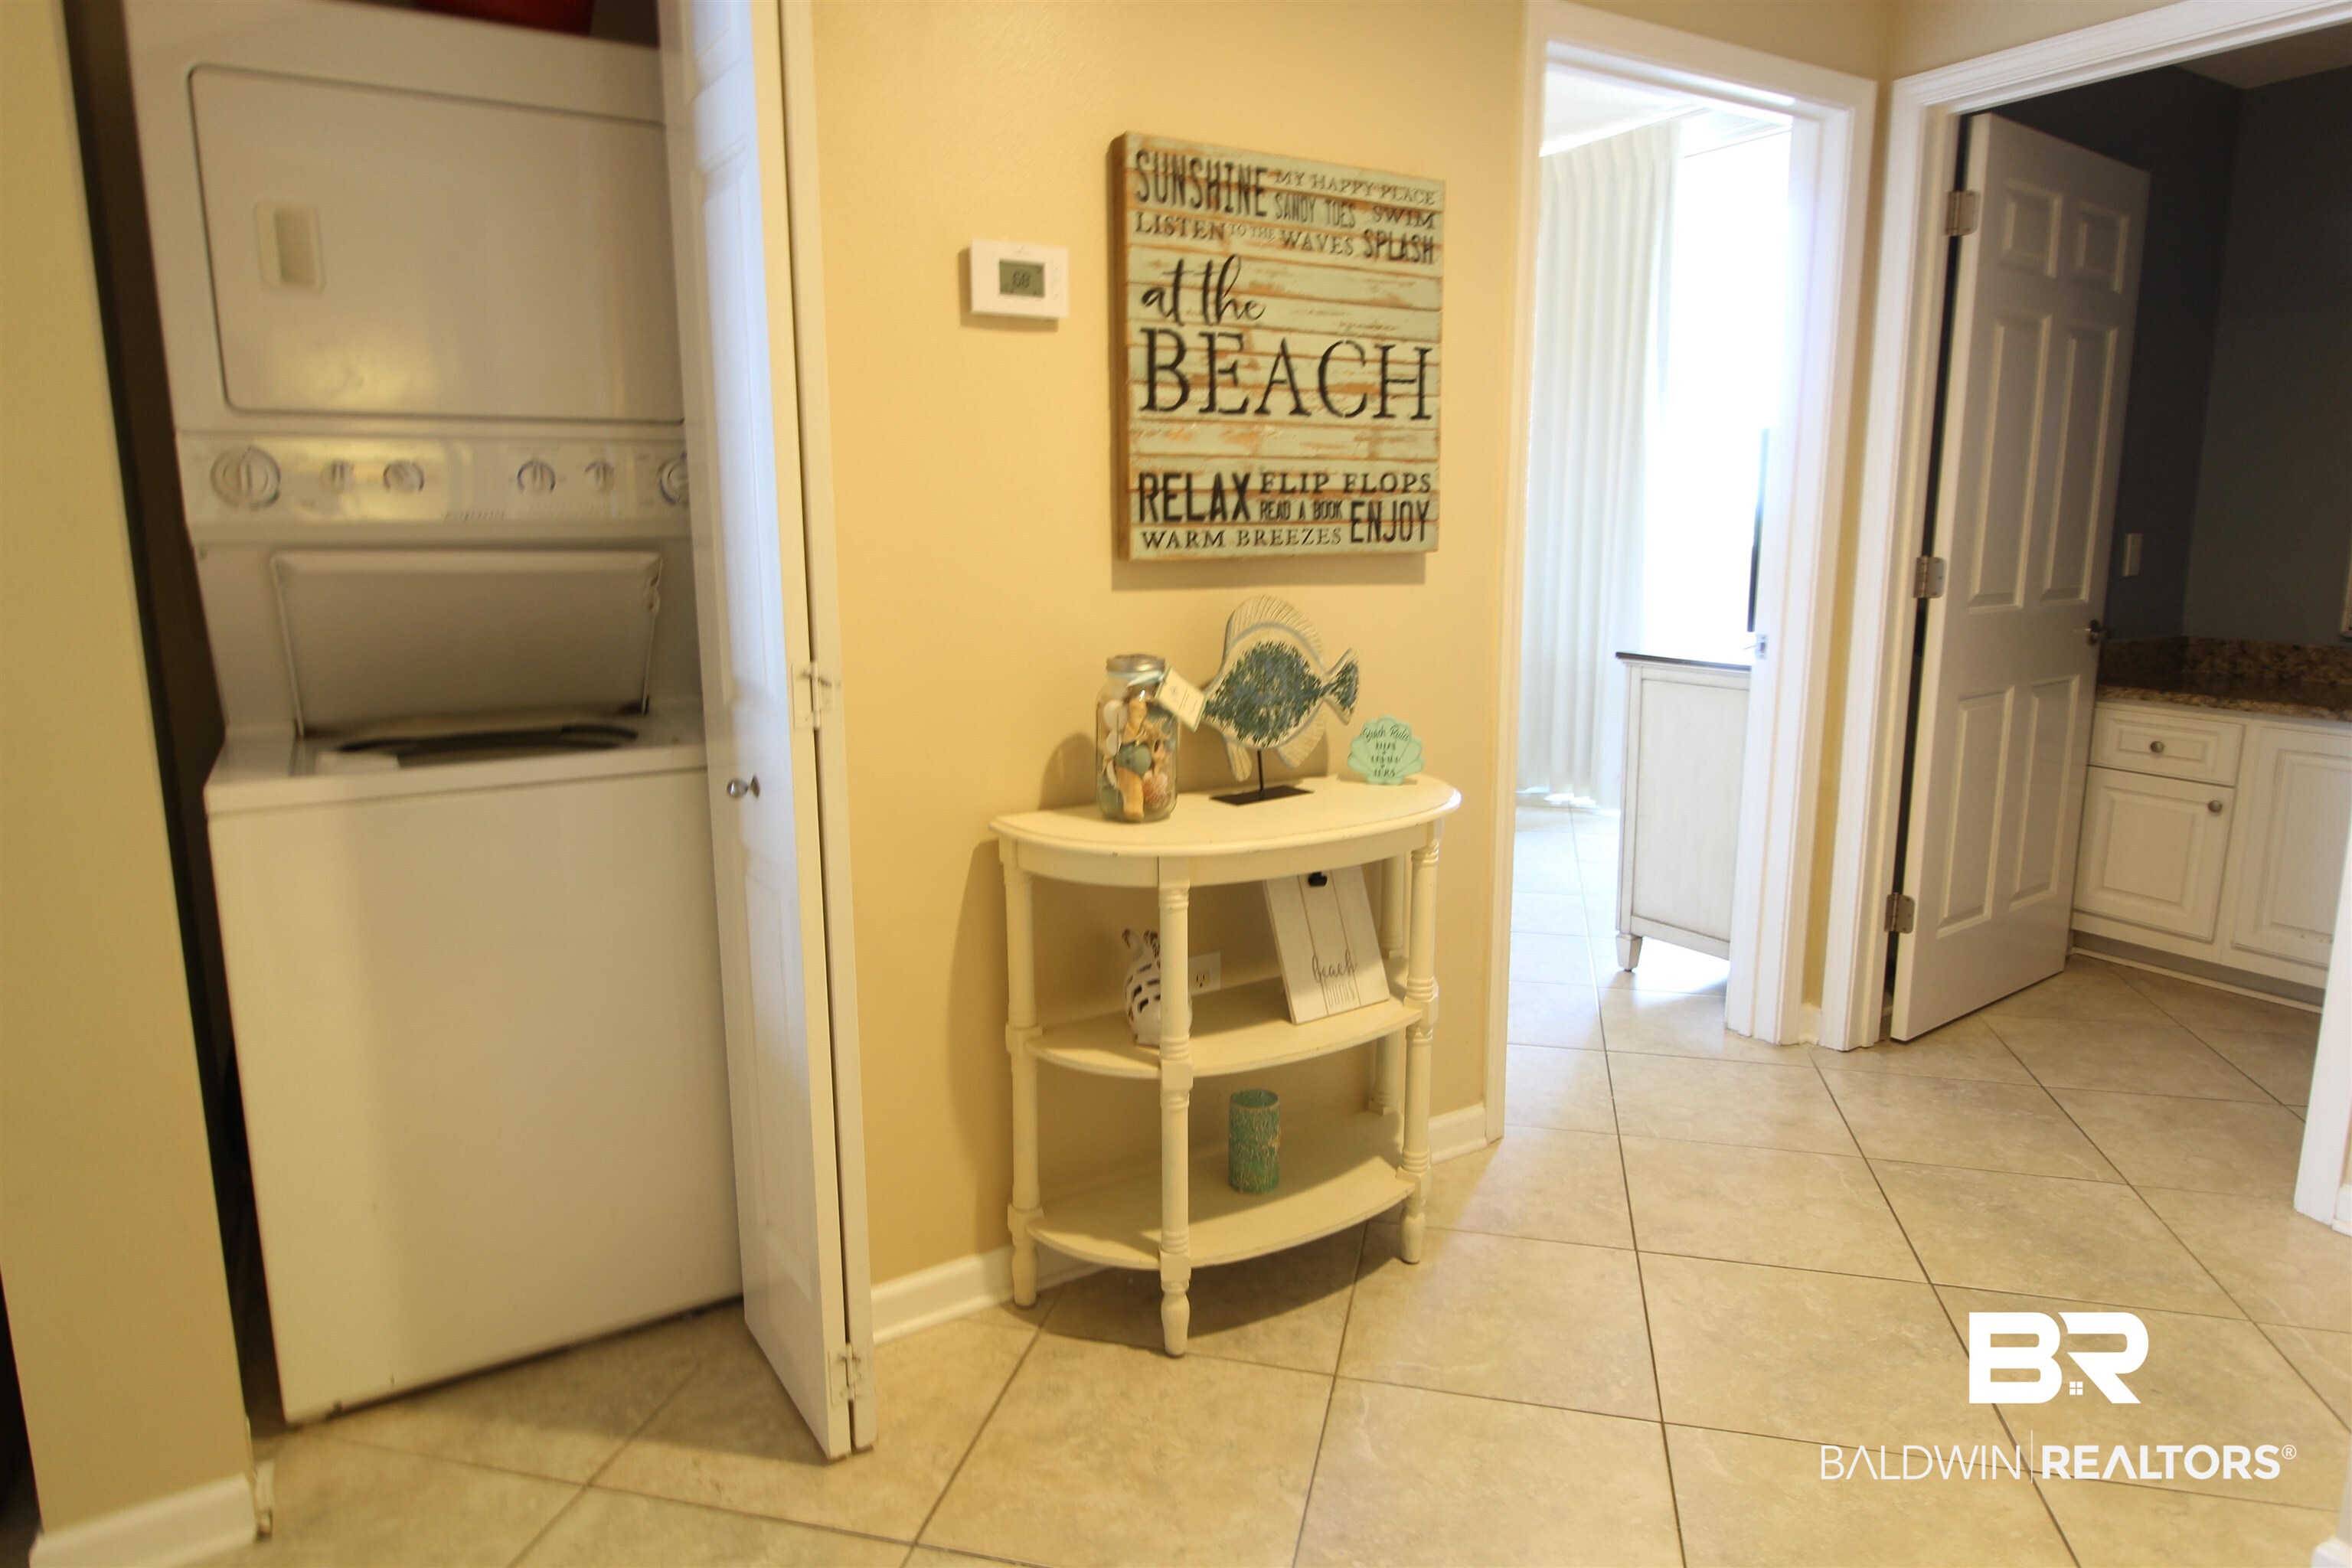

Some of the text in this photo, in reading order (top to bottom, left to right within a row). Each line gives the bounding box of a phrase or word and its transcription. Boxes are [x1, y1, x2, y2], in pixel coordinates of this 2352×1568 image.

[1135, 149, 1269, 217] SUNSHINE
[1273, 168, 1436, 206] MY HAPPY PLACE
[1274, 193, 1357, 228] SANDY TOES
[1371, 206, 1436, 230] SWIM
[1135, 211, 1355, 256] LISTEN TO THE WAVES
[1363, 228, 1434, 265] SPLASH
[1141, 253, 1267, 327] at the
[1139, 327, 1432, 421] BEACH
[1138, 472, 1252, 524] RELAX
[1259, 472, 1432, 495] FLIP FLOPS
[1259, 498, 1344, 522] READ A BOOK
[1350, 499, 1431, 544] ENJOY
[1142, 527, 1342, 551] WARM BREEZES
